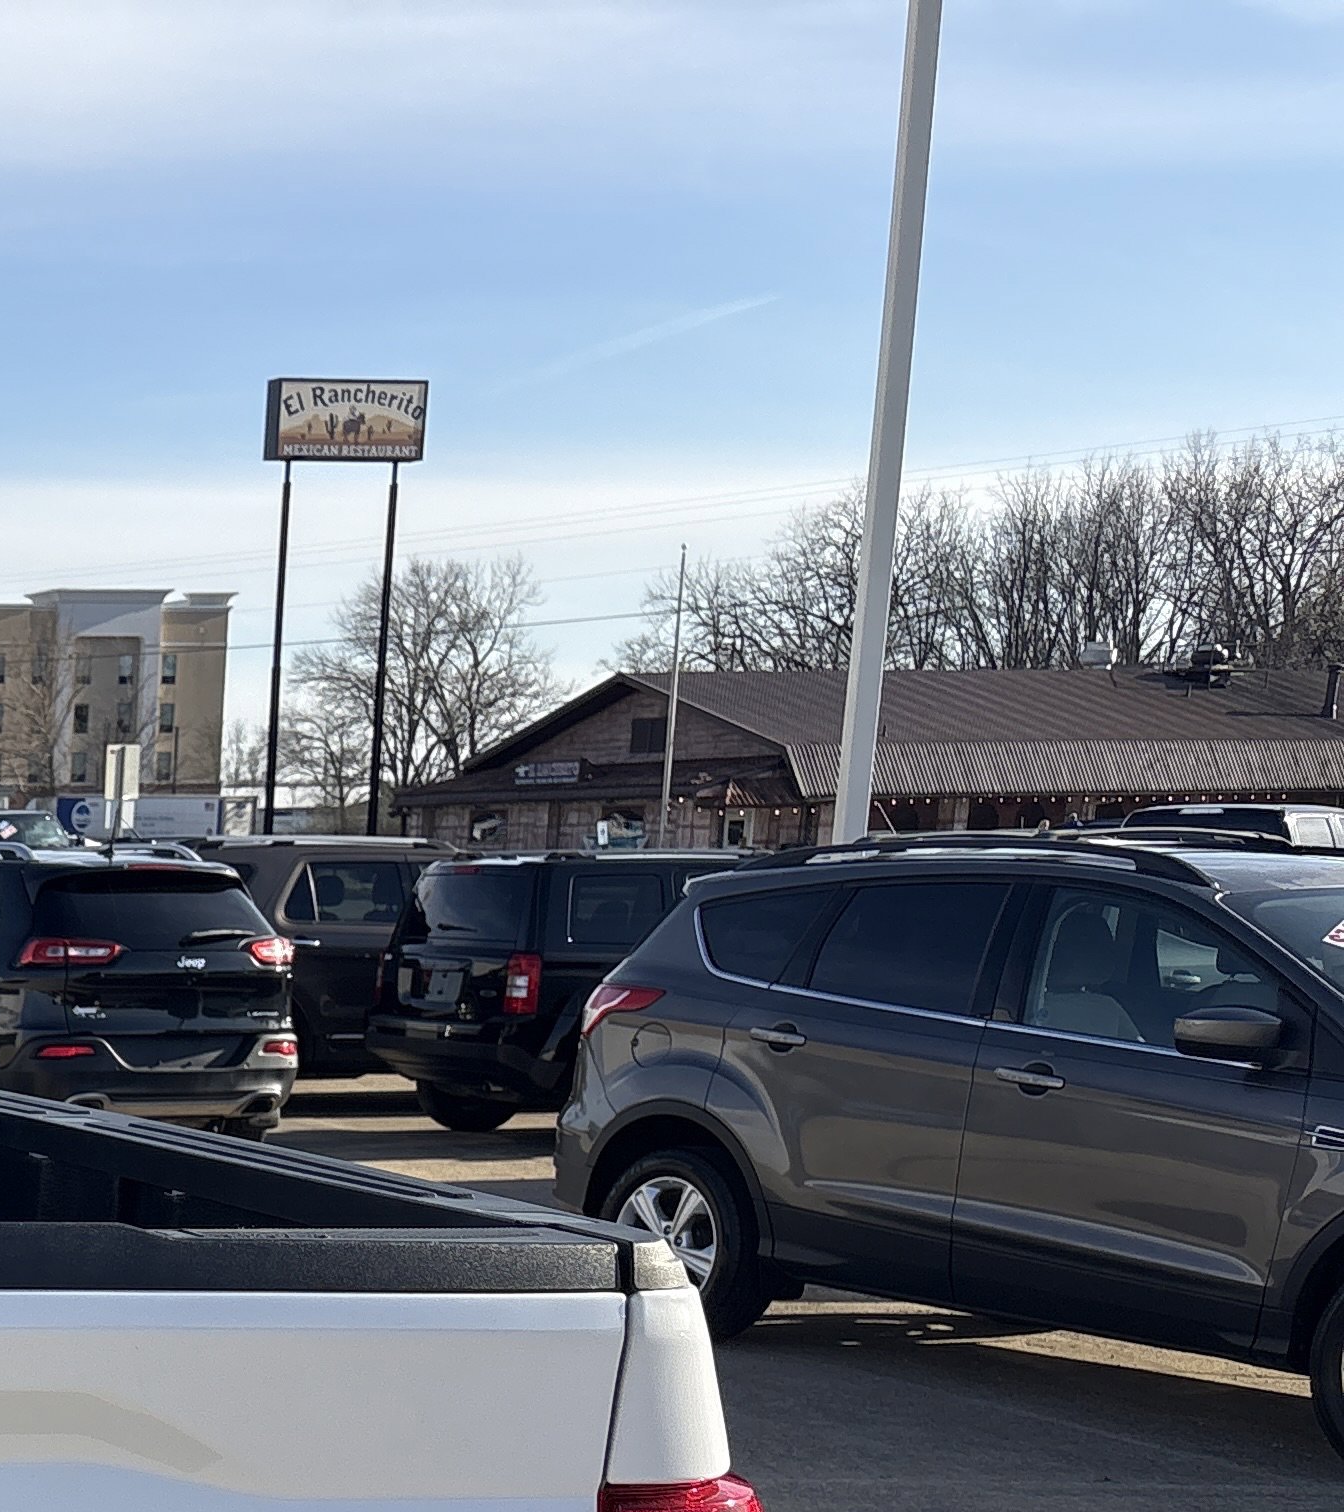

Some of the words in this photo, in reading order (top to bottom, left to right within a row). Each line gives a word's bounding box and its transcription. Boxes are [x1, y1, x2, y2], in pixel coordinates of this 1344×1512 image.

[283, 391, 305, 417] El
[312, 383, 424, 421] Rancherito
[283, 444, 338, 456] MEXICAN
[341, 445, 418, 457] RESTAURANT
[177, 955, 206, 970] Jeep
